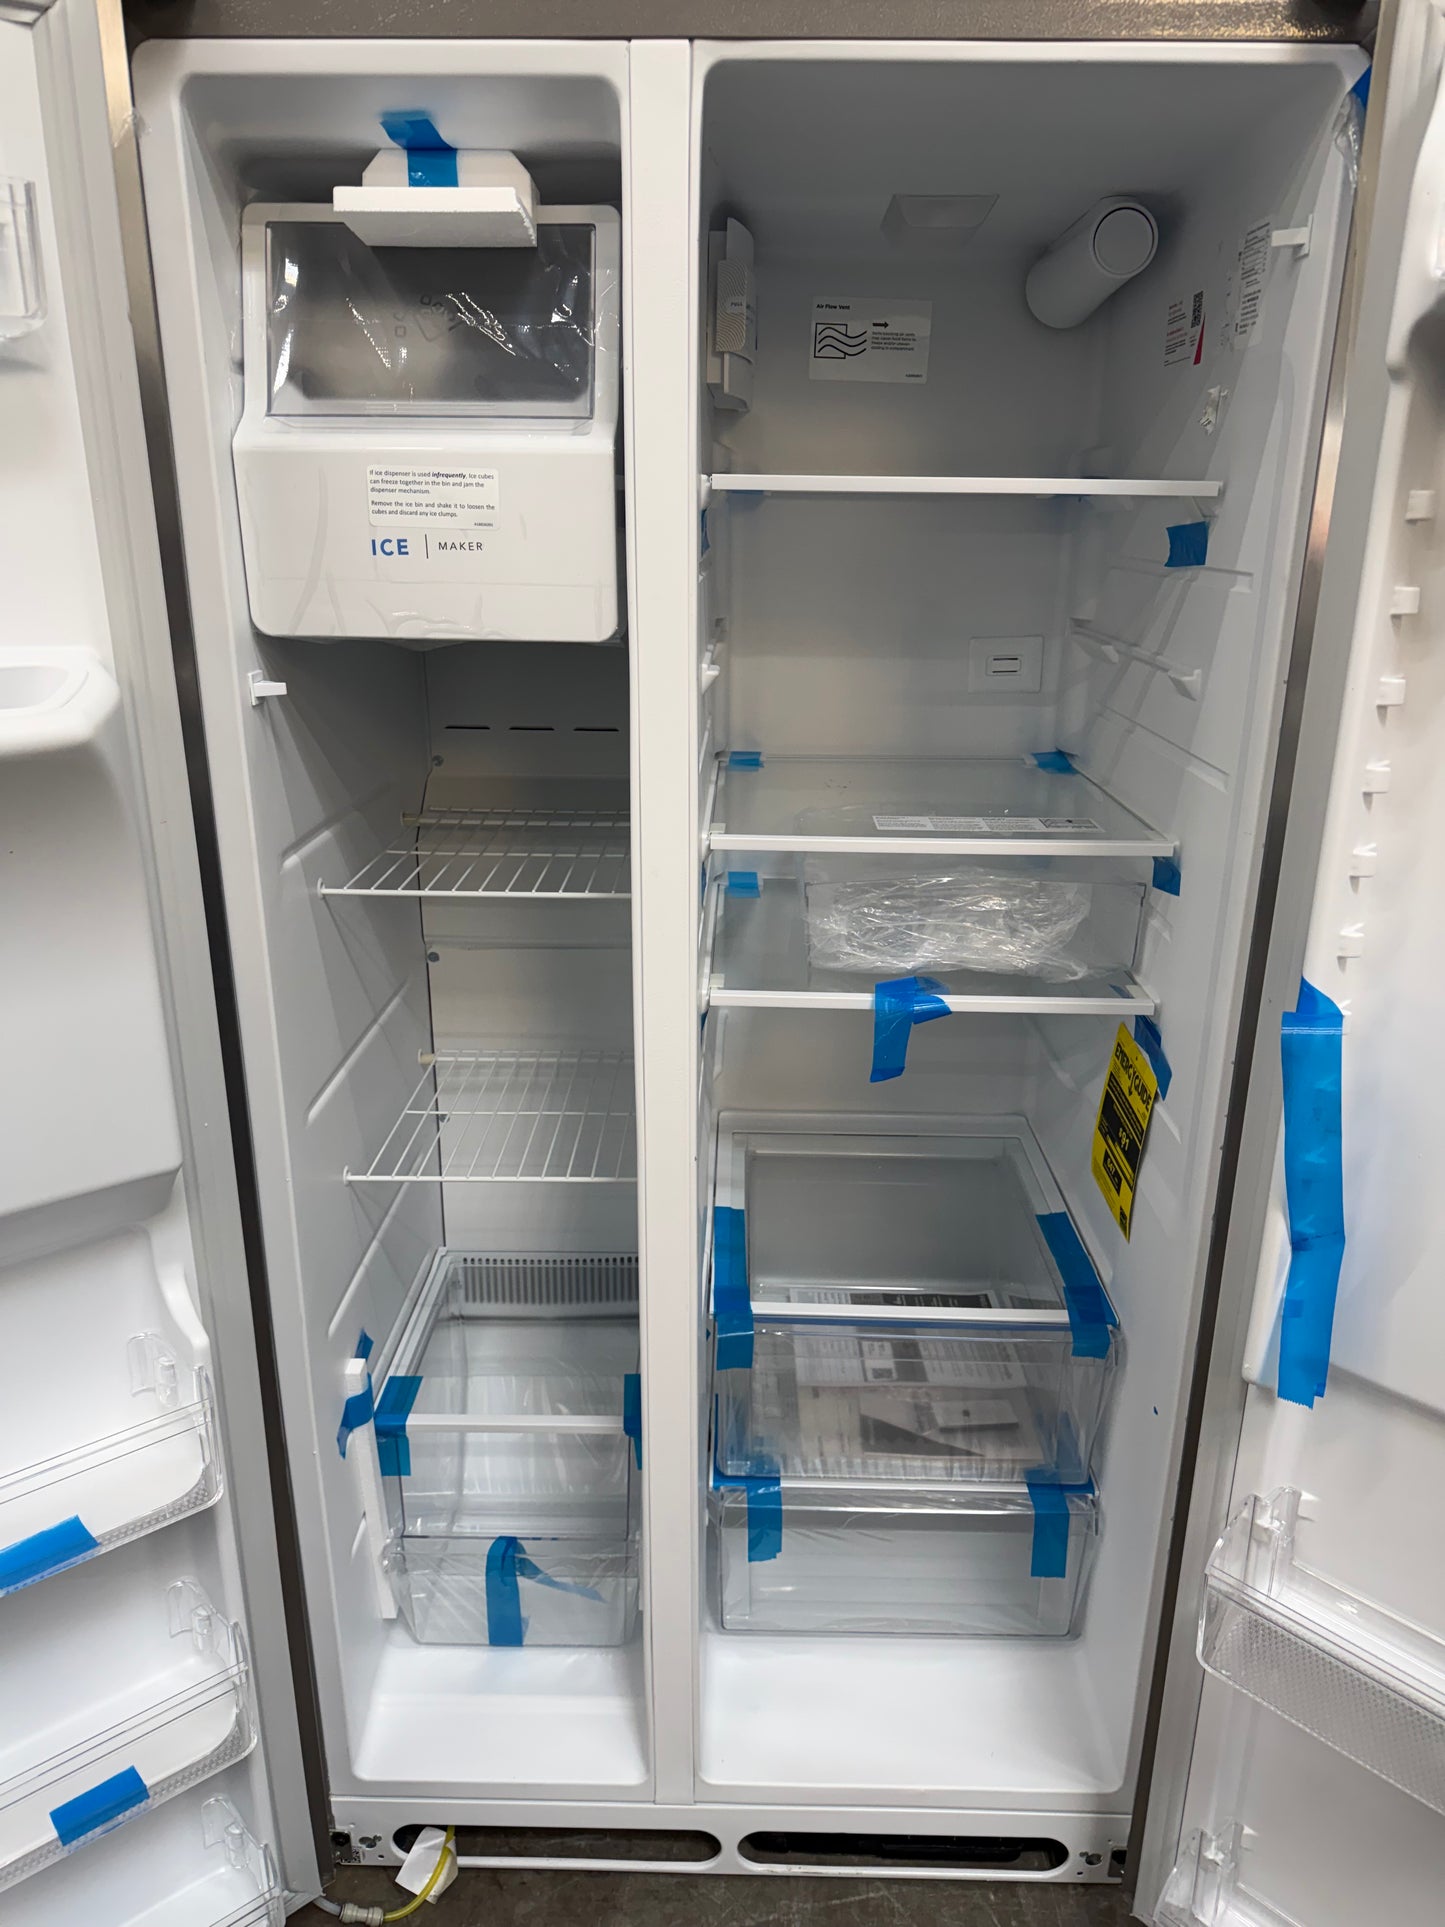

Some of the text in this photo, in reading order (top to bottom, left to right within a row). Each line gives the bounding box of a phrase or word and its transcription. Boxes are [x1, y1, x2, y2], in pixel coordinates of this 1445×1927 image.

[384, 470, 411, 478] dispenser
[371, 538, 483, 556] ICE MAKER
